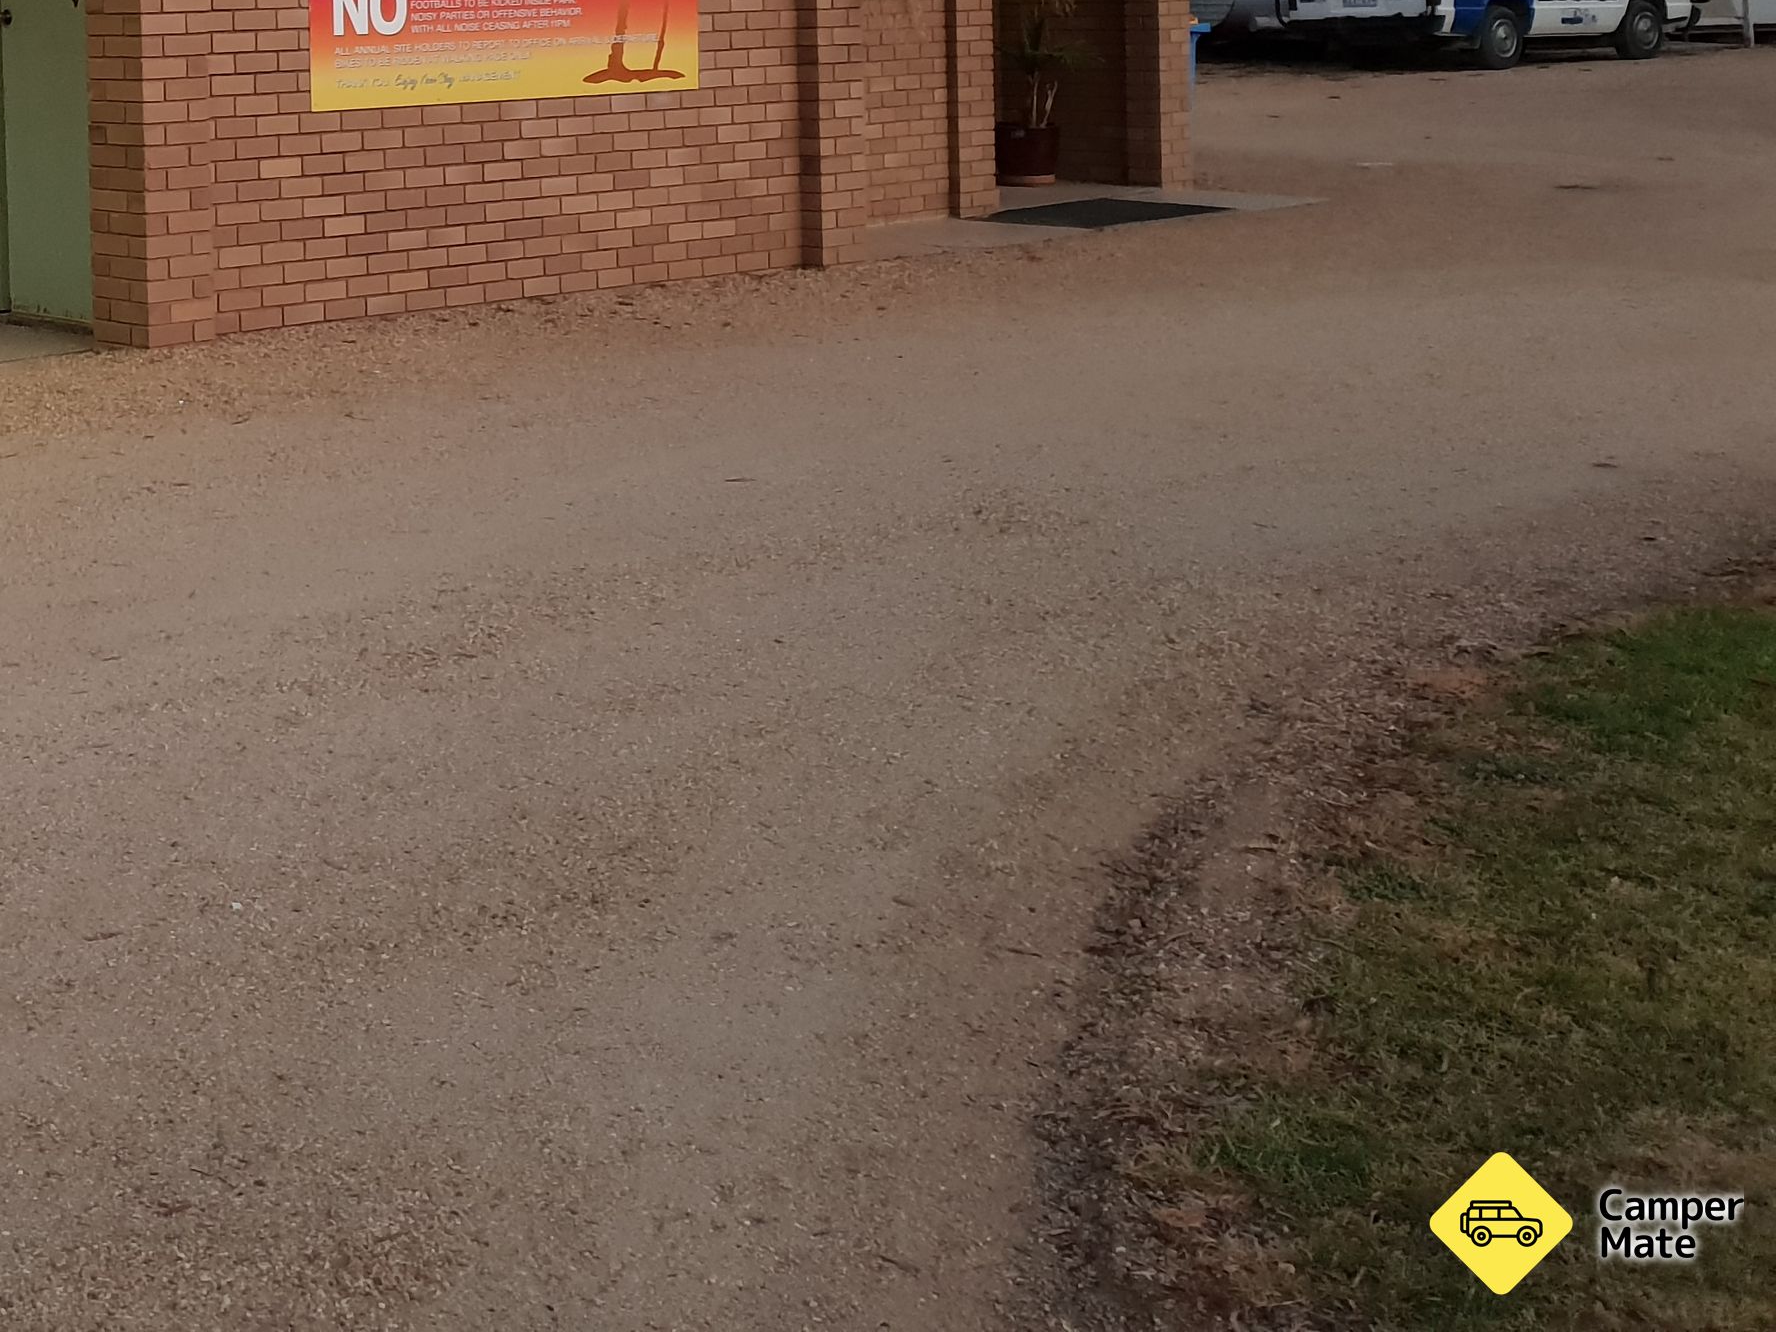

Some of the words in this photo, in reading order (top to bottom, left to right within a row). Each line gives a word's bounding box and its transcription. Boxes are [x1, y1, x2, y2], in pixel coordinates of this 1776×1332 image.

[410, 0, 462, 9] FOOTBALLS
[411, 12, 437, 22] NOISY
[439, 11, 476, 21] PARTIES
[477, 10, 490, 19] OR
[492, 8, 538, 18] OFFENSIVE
[411, 24, 434, 34] WITH
[436, 24, 452, 33] ALL
[454, 22, 480, 32] NOISE
[522, 20, 549, 29] AFTER
[393, 43, 412, 54] SITE
